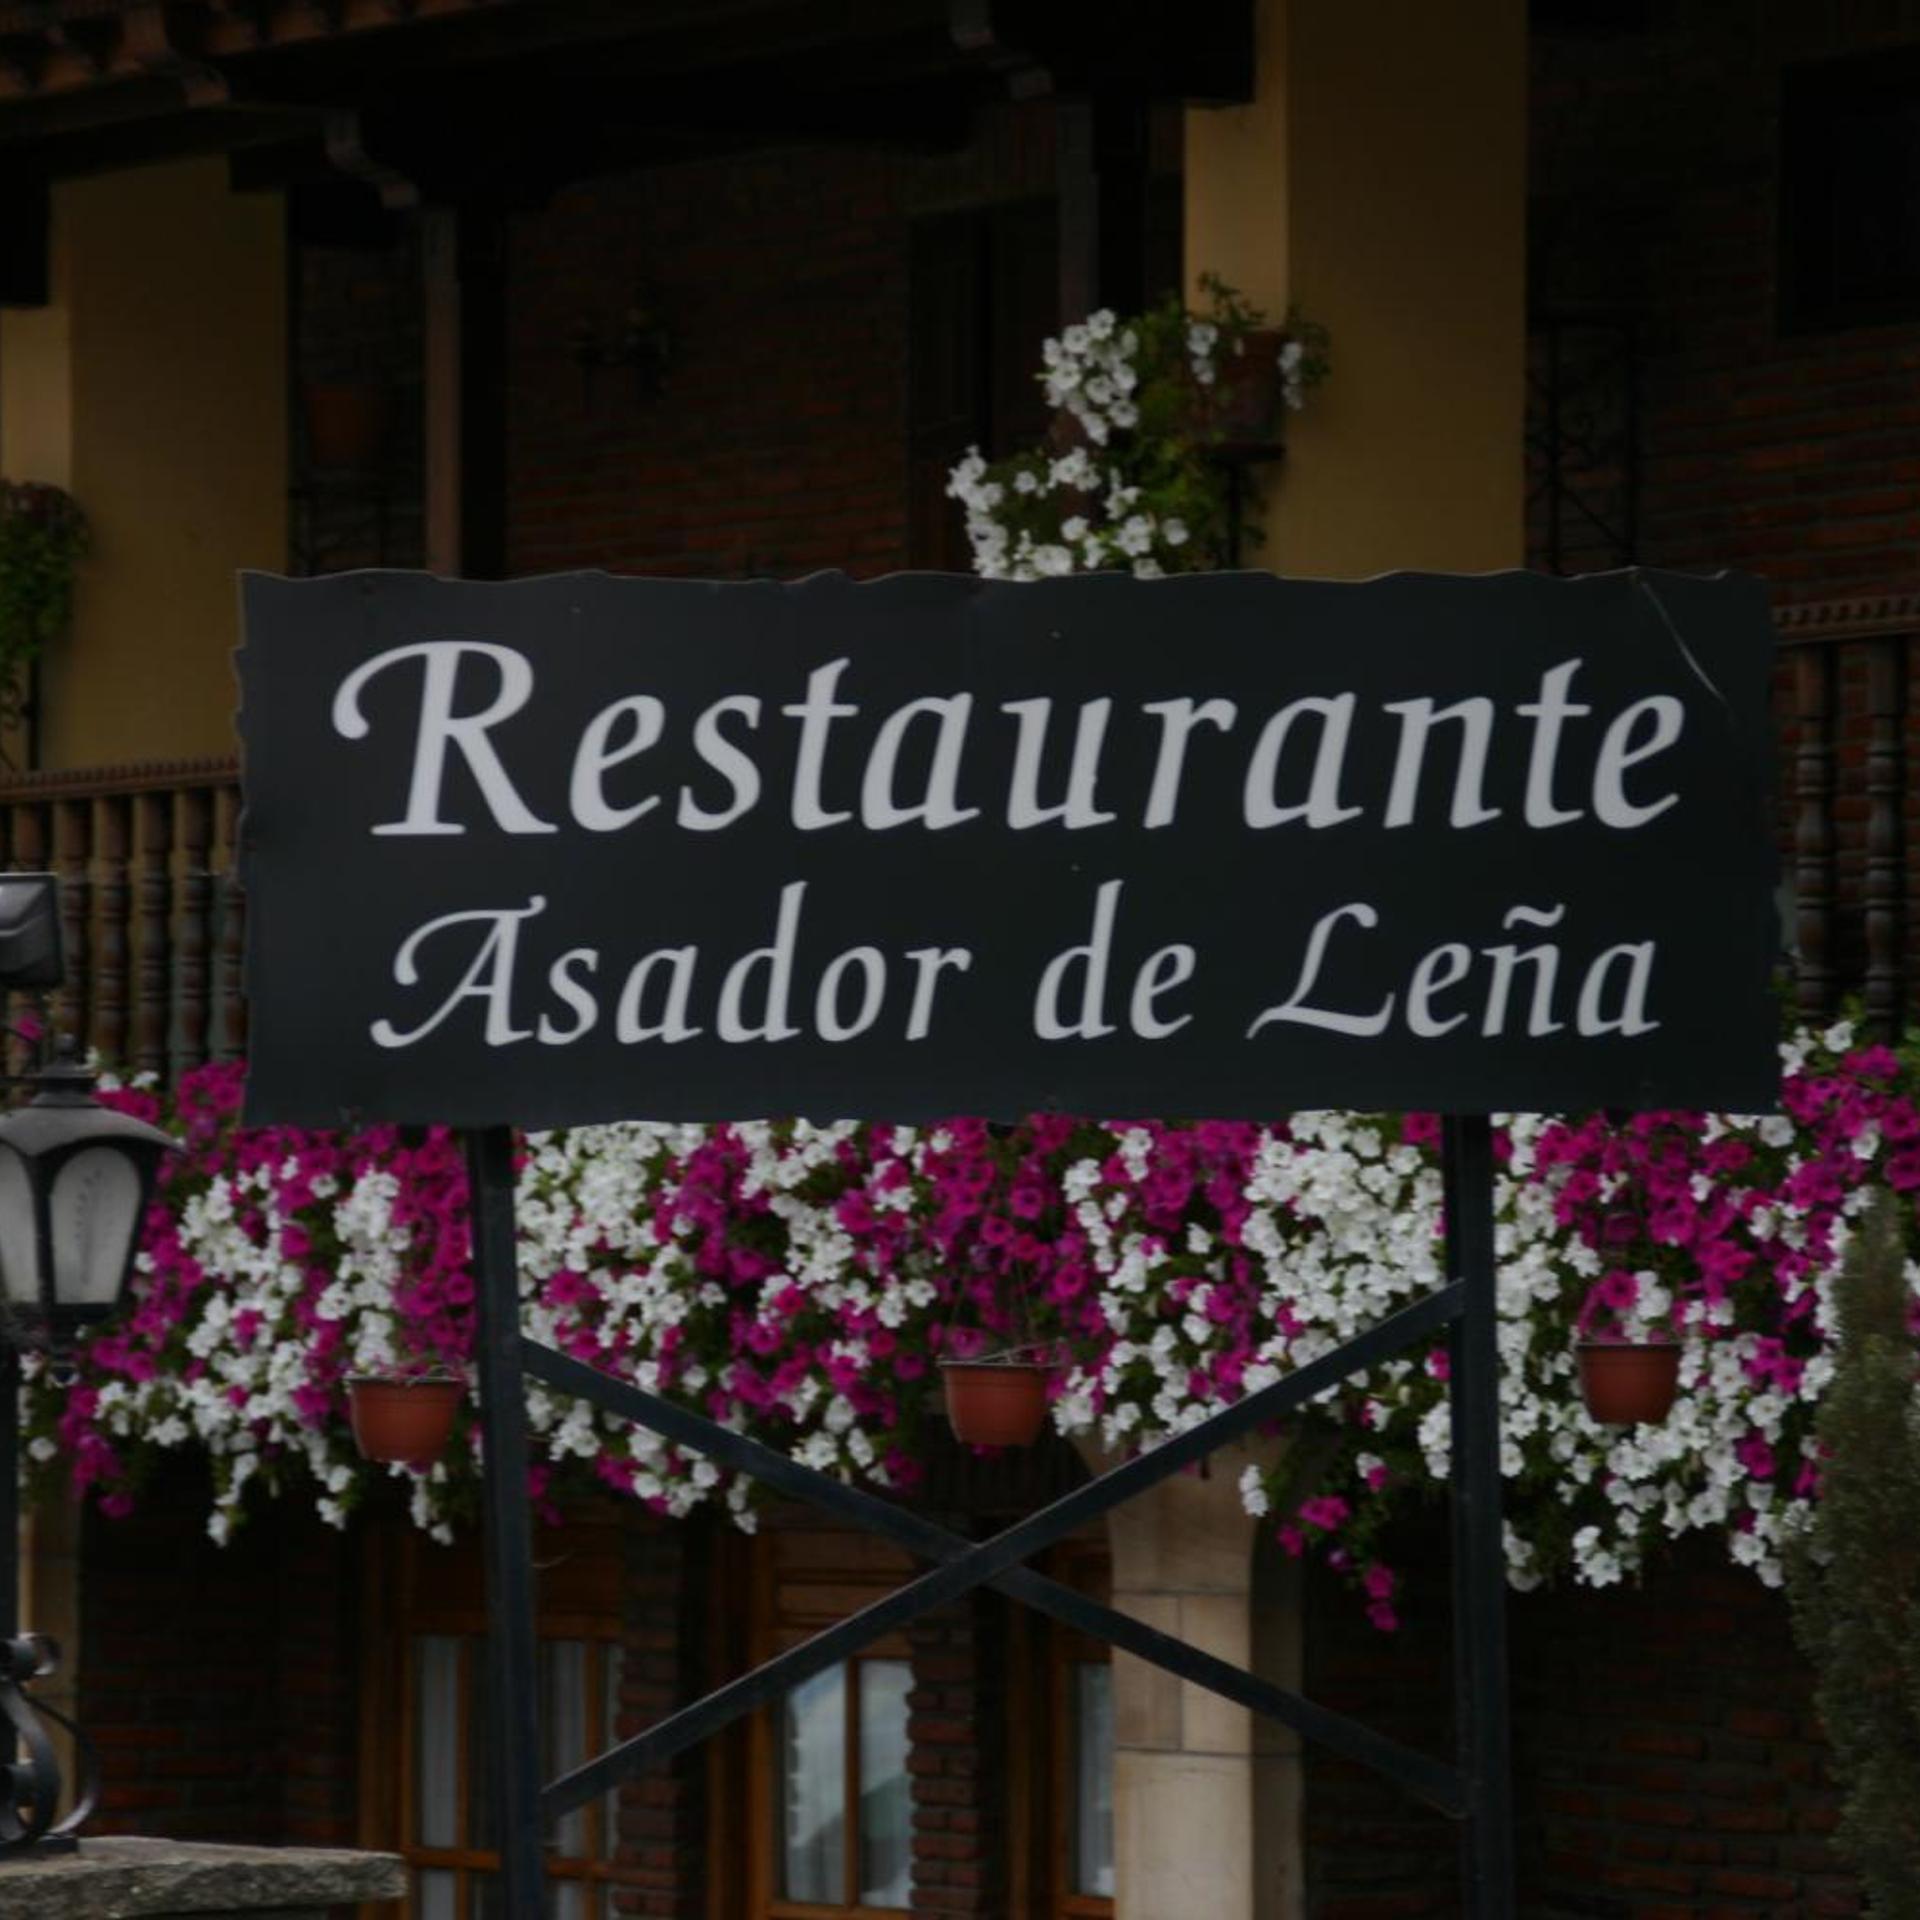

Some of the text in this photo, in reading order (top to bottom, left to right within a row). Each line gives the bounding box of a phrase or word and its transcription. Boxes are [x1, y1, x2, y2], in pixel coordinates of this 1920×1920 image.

[331, 640, 1687, 838] Restaurante
[370, 879, 1660, 1049] Asador de Leña
